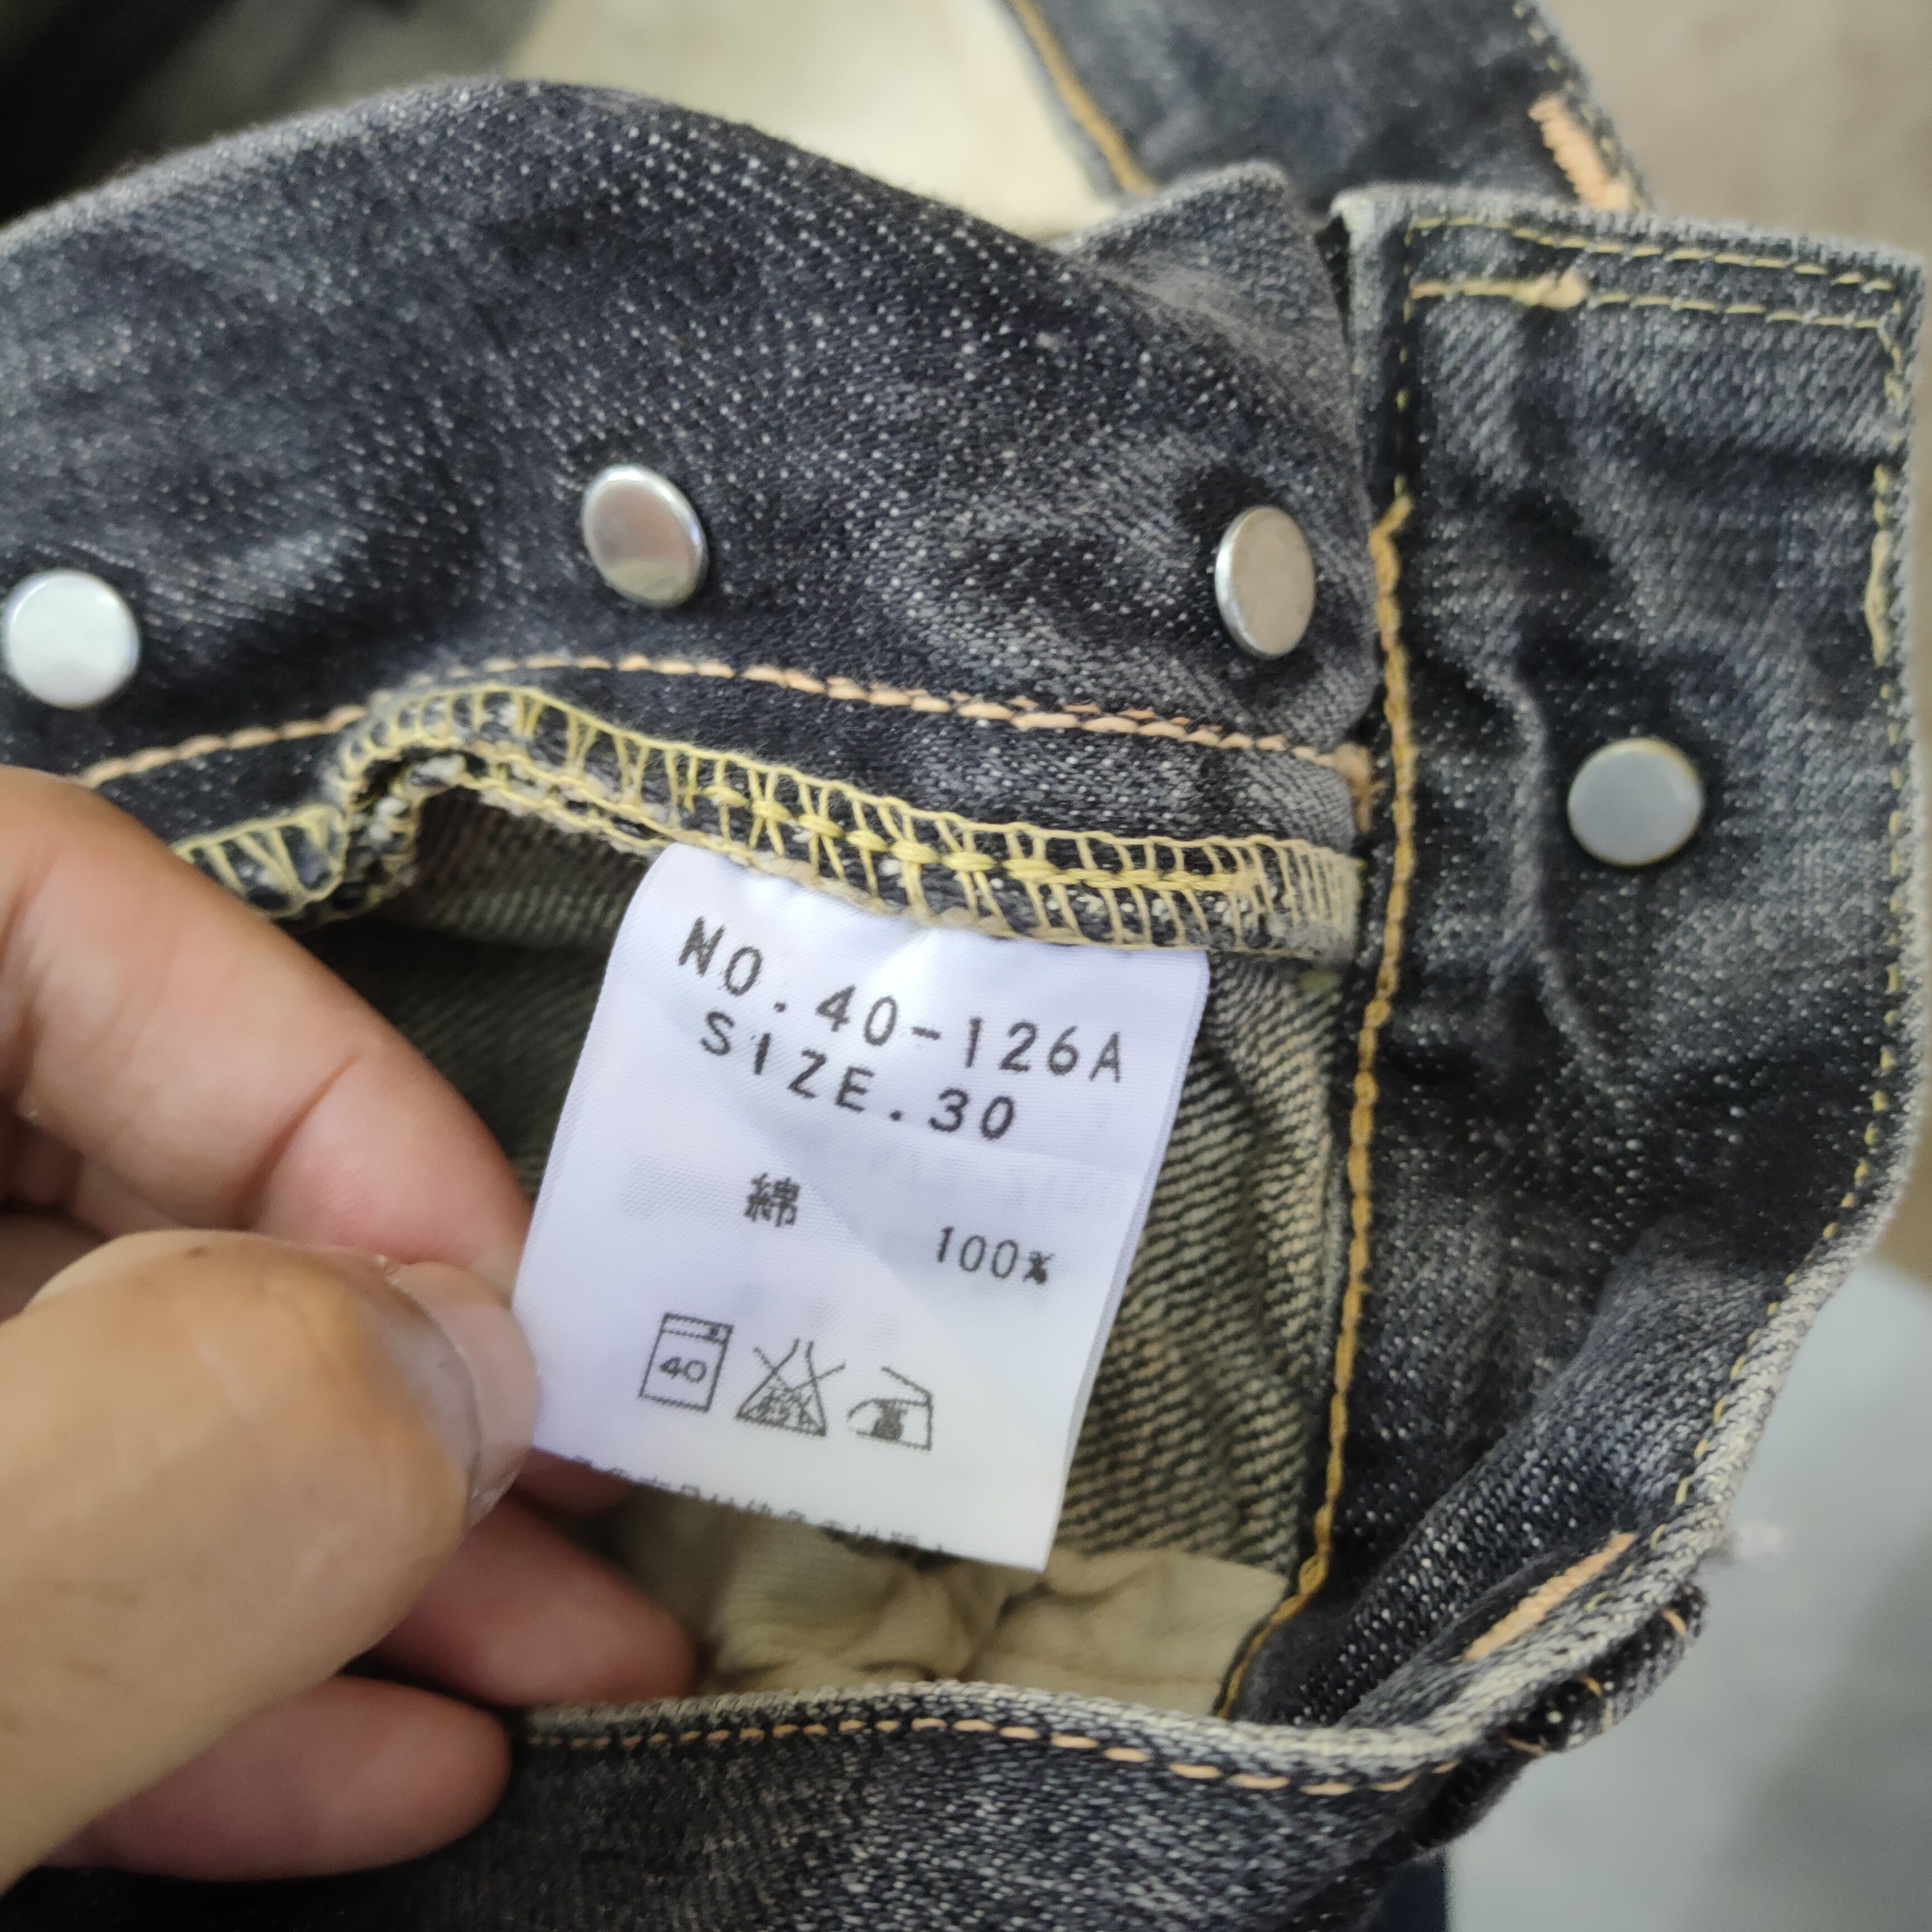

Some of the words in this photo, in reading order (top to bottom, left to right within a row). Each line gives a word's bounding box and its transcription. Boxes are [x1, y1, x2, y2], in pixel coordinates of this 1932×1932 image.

[677, 916, 1122, 1082] NO.40-126A
[699, 1011, 1016, 1140] SIZE.30
[744, 1172, 801, 1227] 綿
[936, 1226, 1054, 1285] 100%
[659, 1357, 707, 1384] 40
